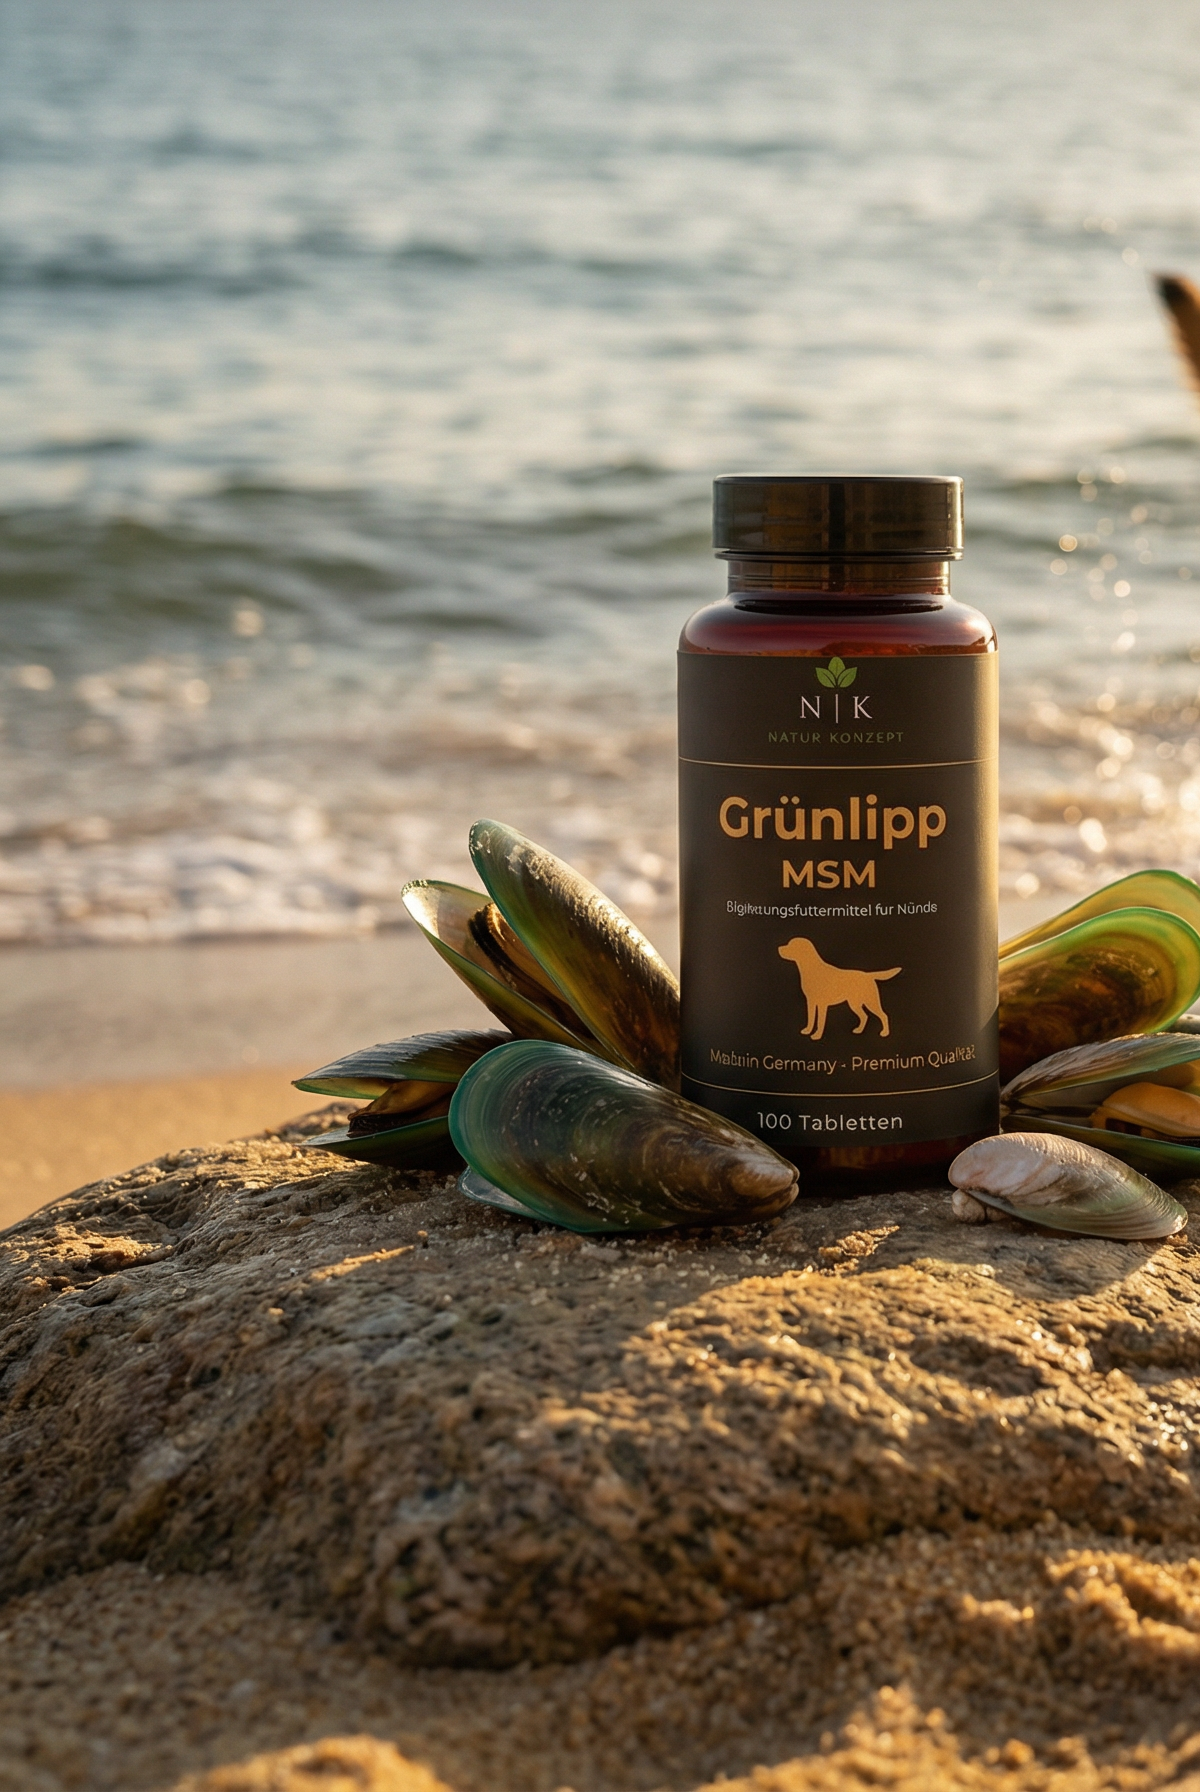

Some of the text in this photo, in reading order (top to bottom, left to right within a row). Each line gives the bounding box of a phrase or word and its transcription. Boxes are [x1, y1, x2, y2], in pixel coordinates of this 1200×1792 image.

[768, 731, 904, 744] NATUR KONZEPT
[719, 794, 947, 850] Grünlipp
[782, 859, 876, 888] MSM
[762, 1055, 837, 1075] Germany
[852, 1054, 925, 1071] Premium
[757, 1112, 903, 1131] 100 Tabletten
